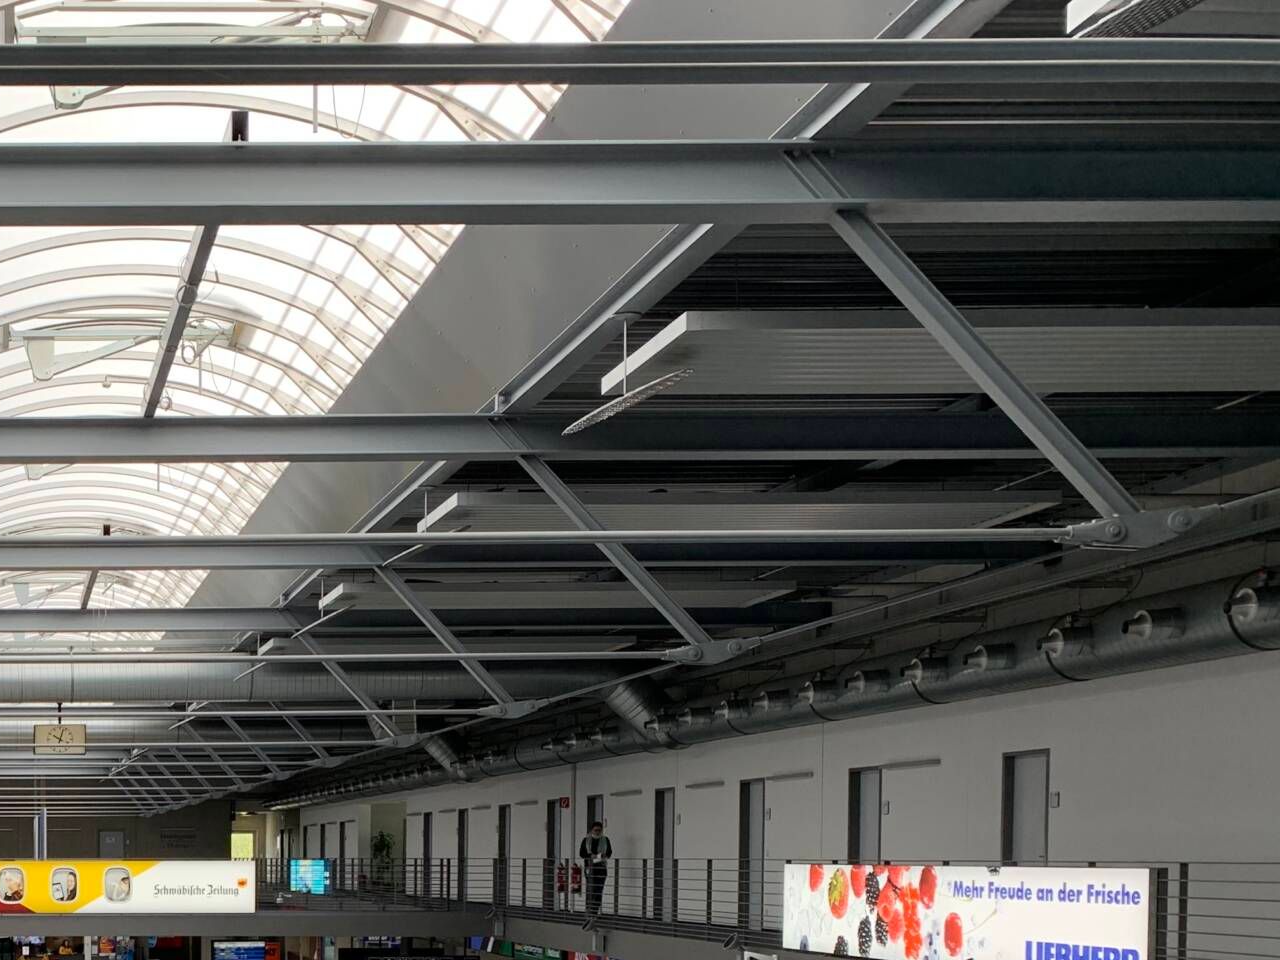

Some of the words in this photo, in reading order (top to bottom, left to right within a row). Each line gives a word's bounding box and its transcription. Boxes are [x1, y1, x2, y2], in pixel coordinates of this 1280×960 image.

[207, 884, 239, 896] Zeitung
[953, 880, 984, 898] Mehr
[988, 881, 1032, 900] Freude
[1037, 888, 1053, 901] an
[1058, 882, 1082, 902] der
[1087, 883, 1141, 905] Frische
